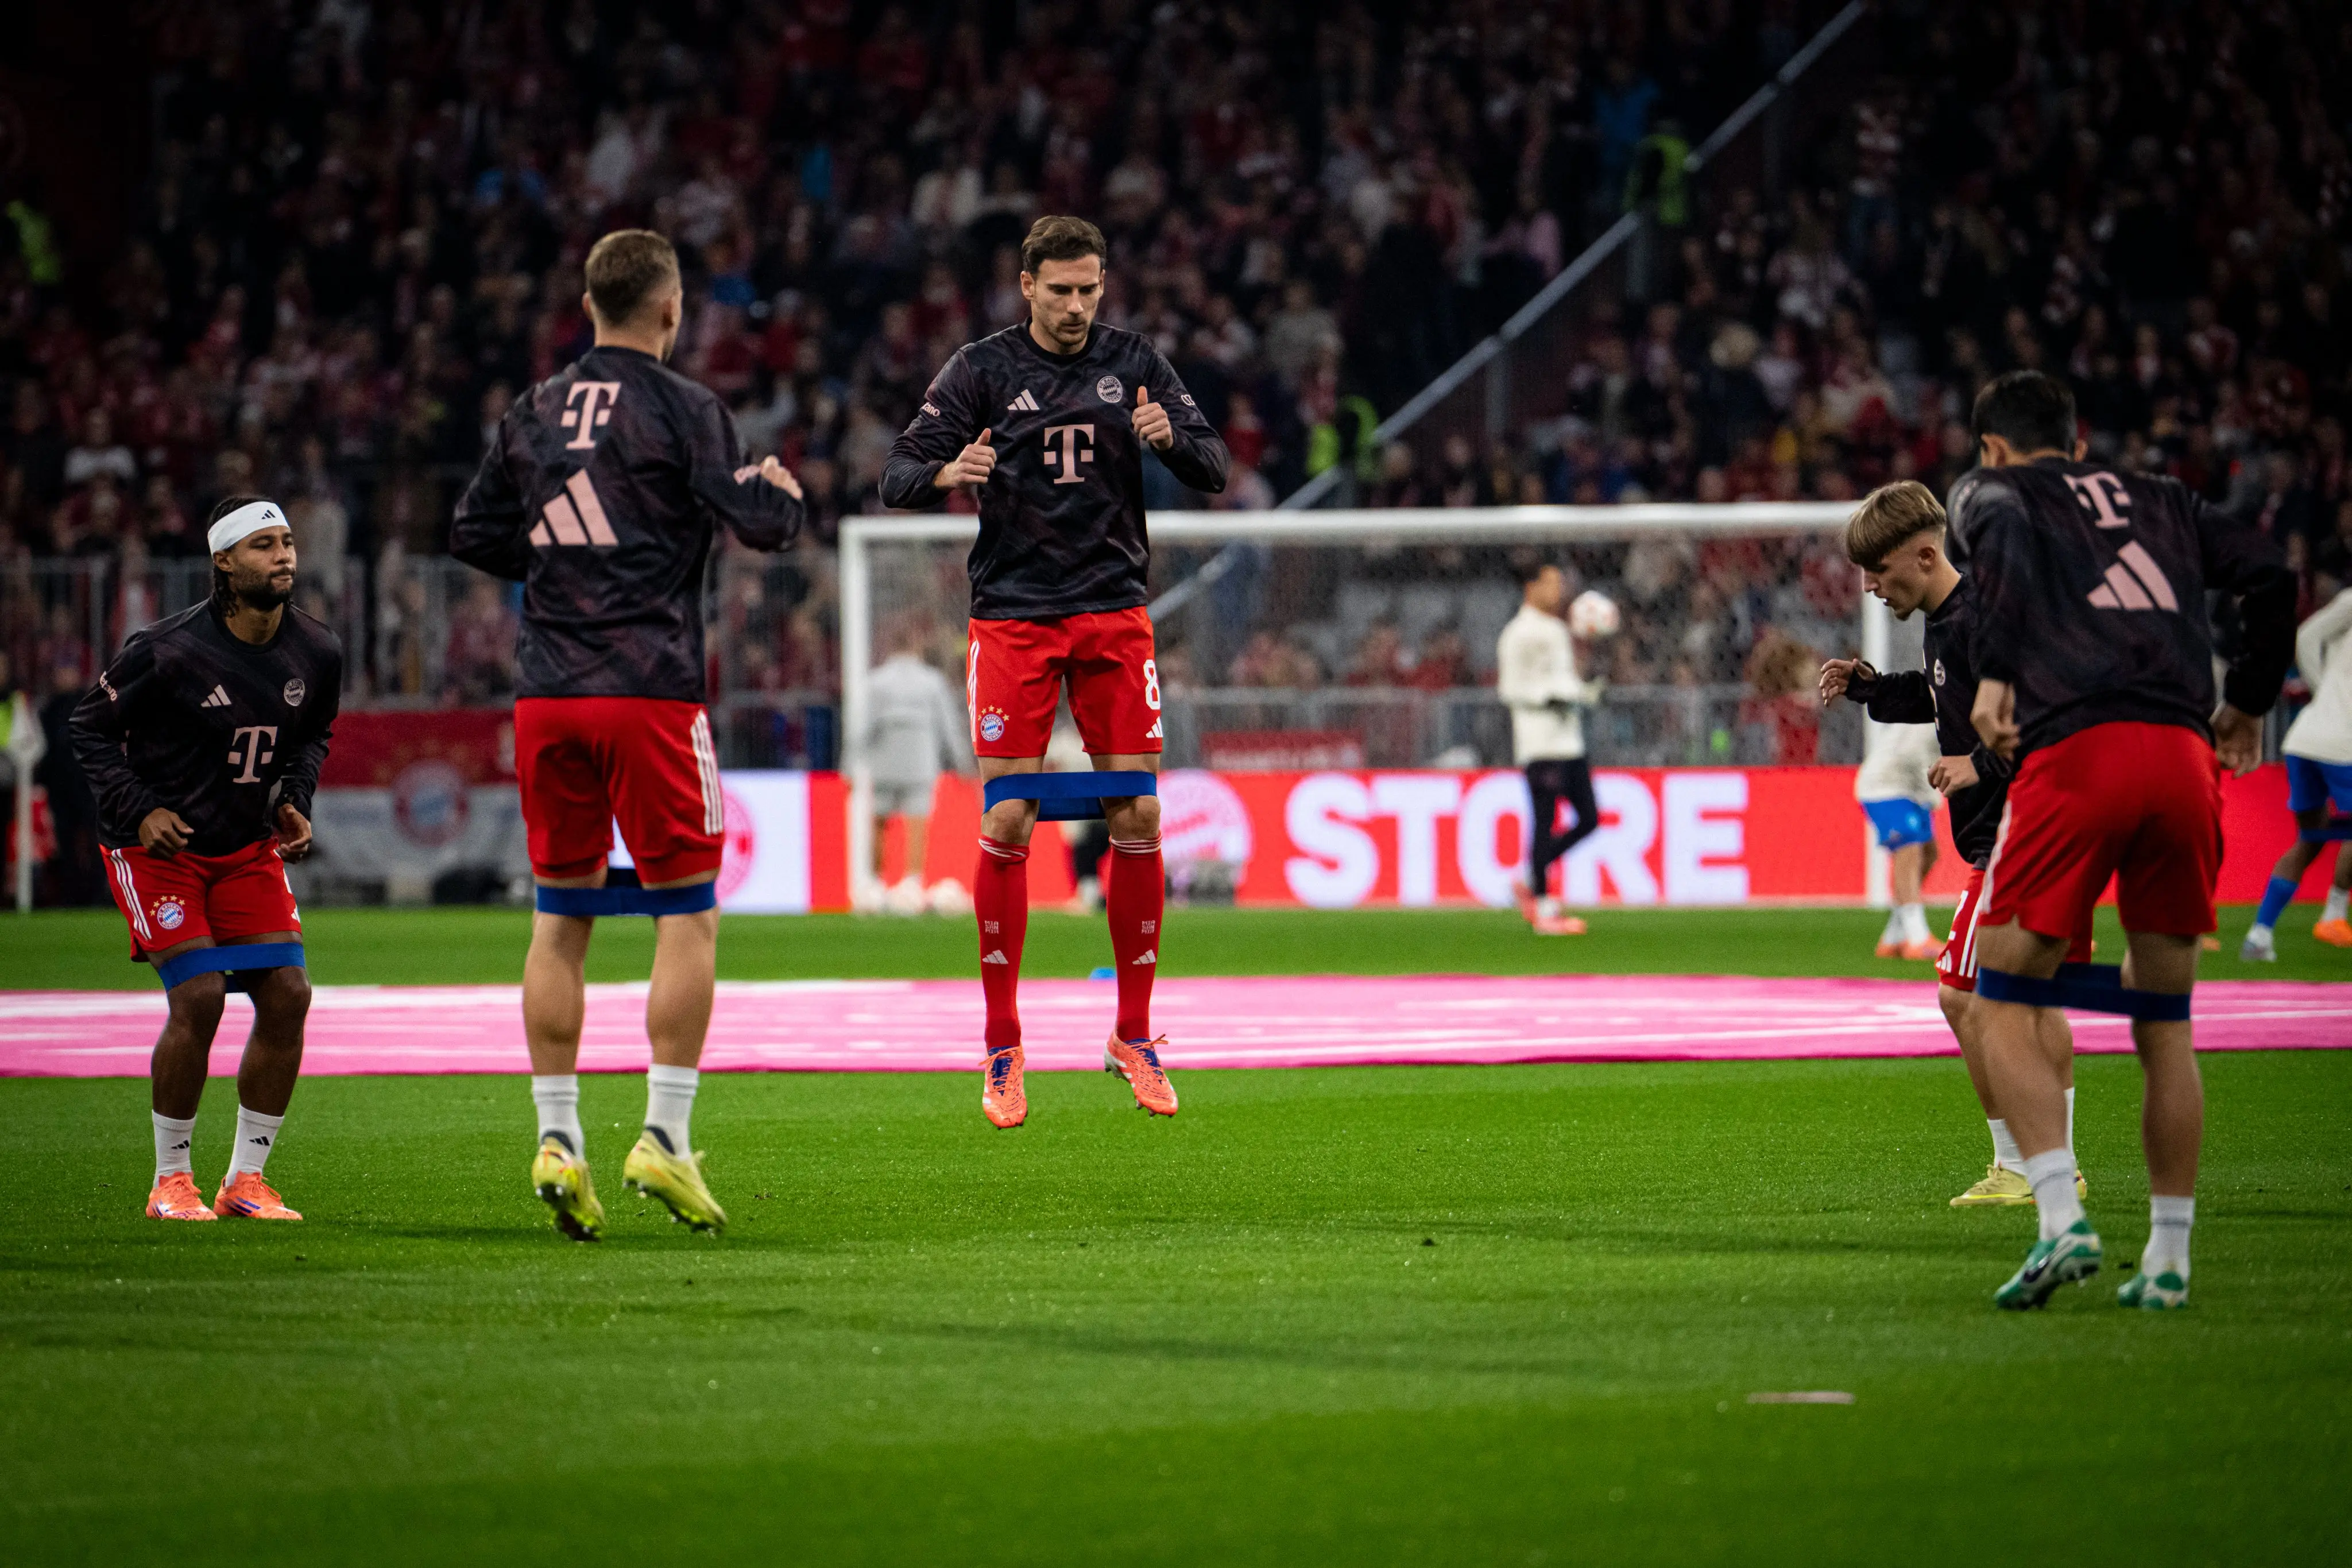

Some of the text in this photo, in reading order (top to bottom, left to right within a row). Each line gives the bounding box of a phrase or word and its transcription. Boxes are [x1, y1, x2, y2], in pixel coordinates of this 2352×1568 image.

[560, 381, 621, 450] T
[1043, 424, 1094, 484] T
[2063, 471, 2131, 529] T
[1143, 659, 1160, 710] 8
[227, 726, 278, 784] T
[1286, 773, 1748, 907] STORE
